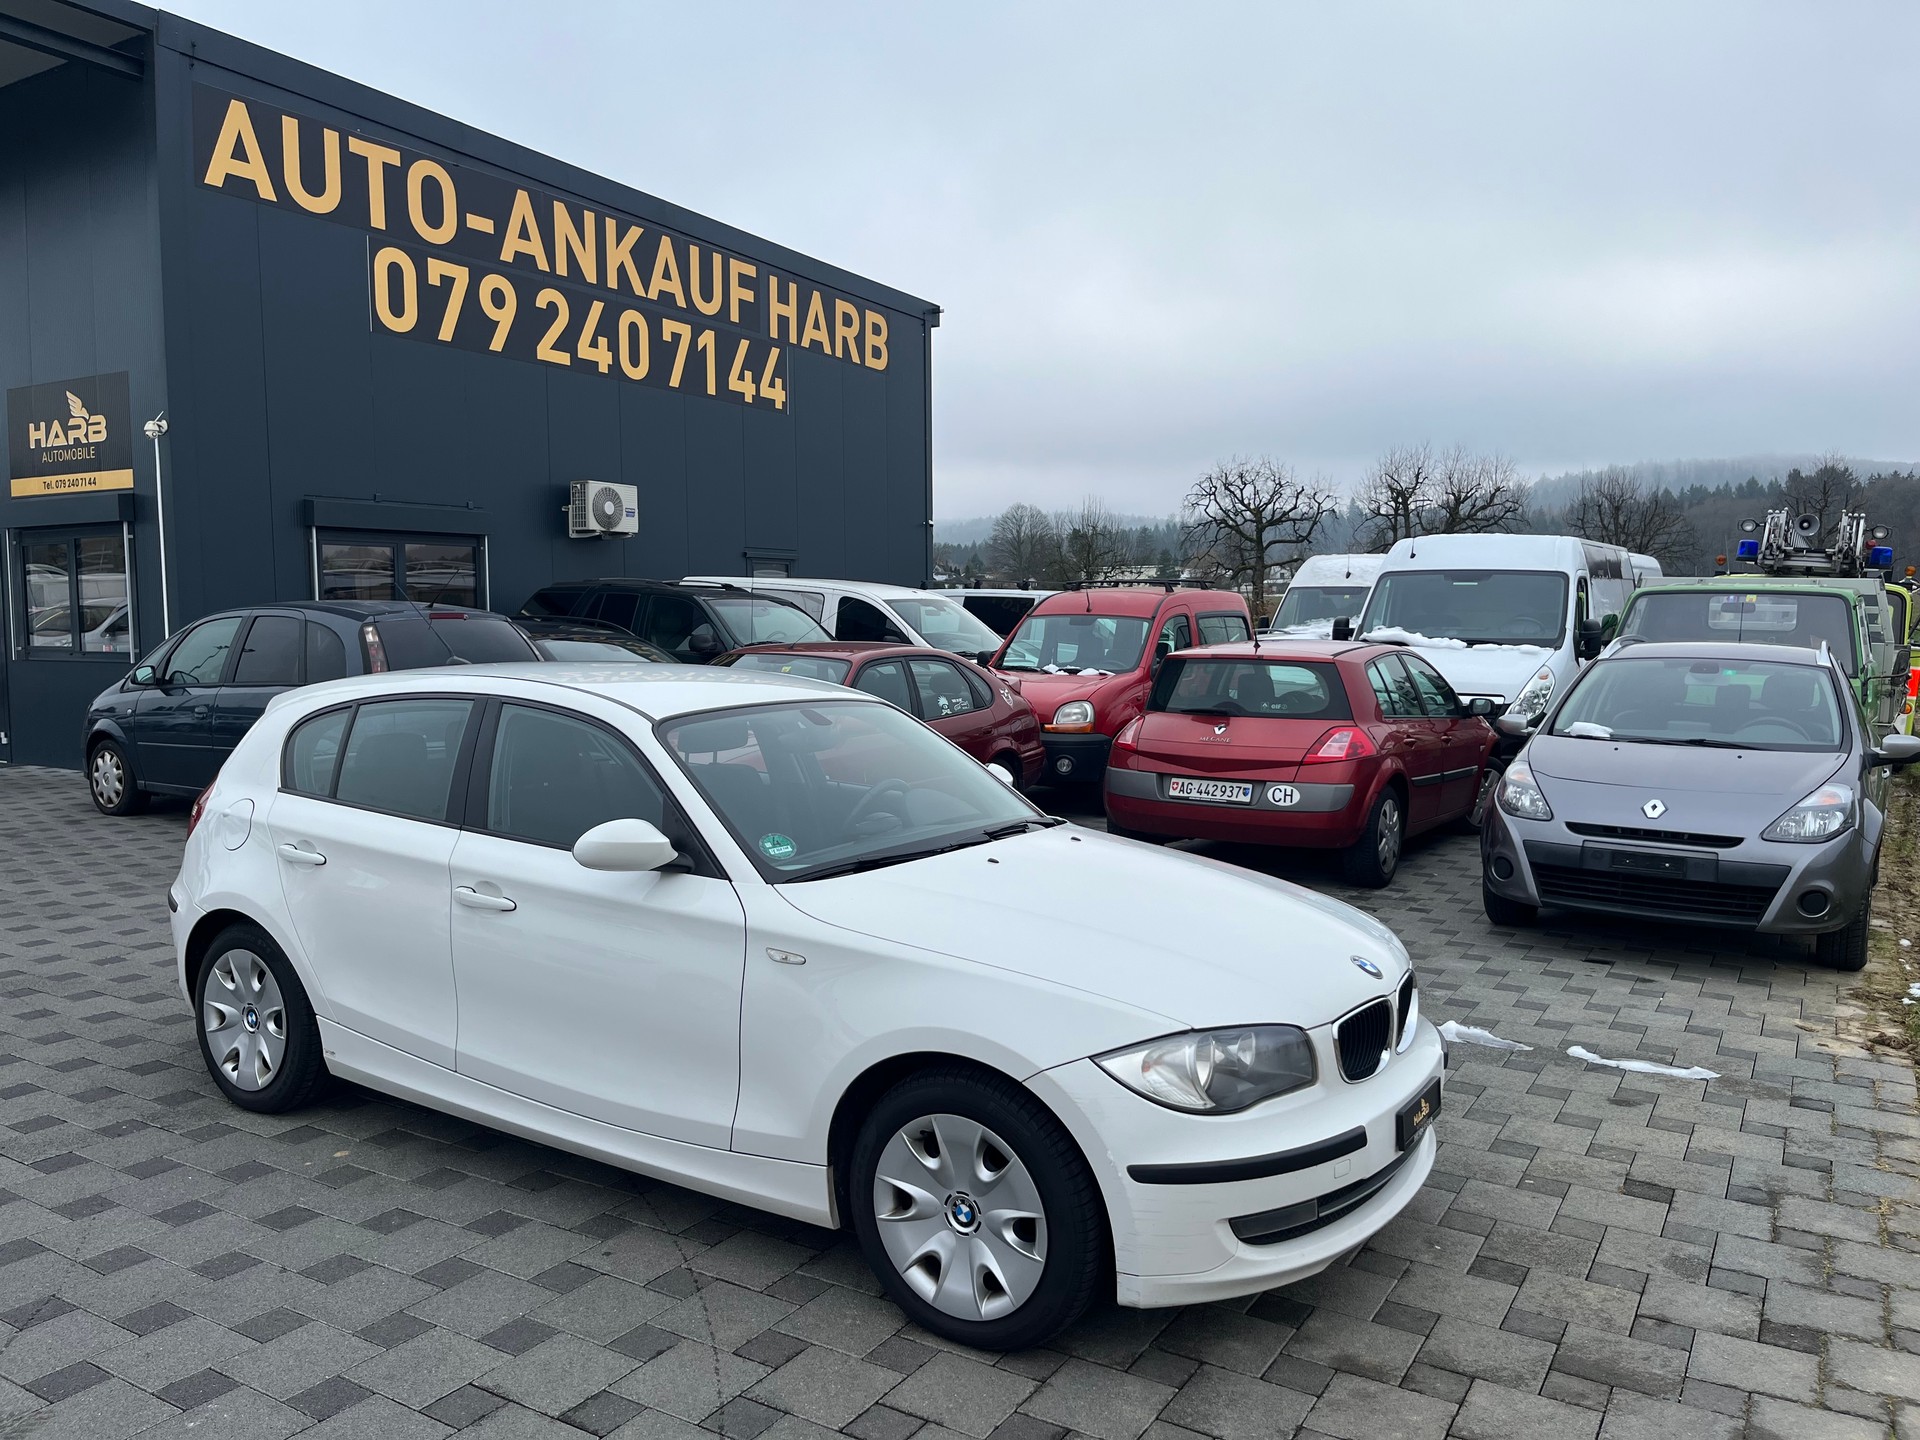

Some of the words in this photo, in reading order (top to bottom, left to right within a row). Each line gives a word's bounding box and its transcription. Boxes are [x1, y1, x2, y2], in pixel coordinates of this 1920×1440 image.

[204, 100, 757, 322] AUTO-ANKAUF
[769, 276, 888, 370] HARB
[374, 247, 517, 352] 079
[535, 288, 650, 380] 240
[29, 415, 107, 449] HARB
[41, 446, 96, 463] AUTOMOBILE
[43, 481, 54, 490] Tel.
[1272, 788, 1294, 804] CH
